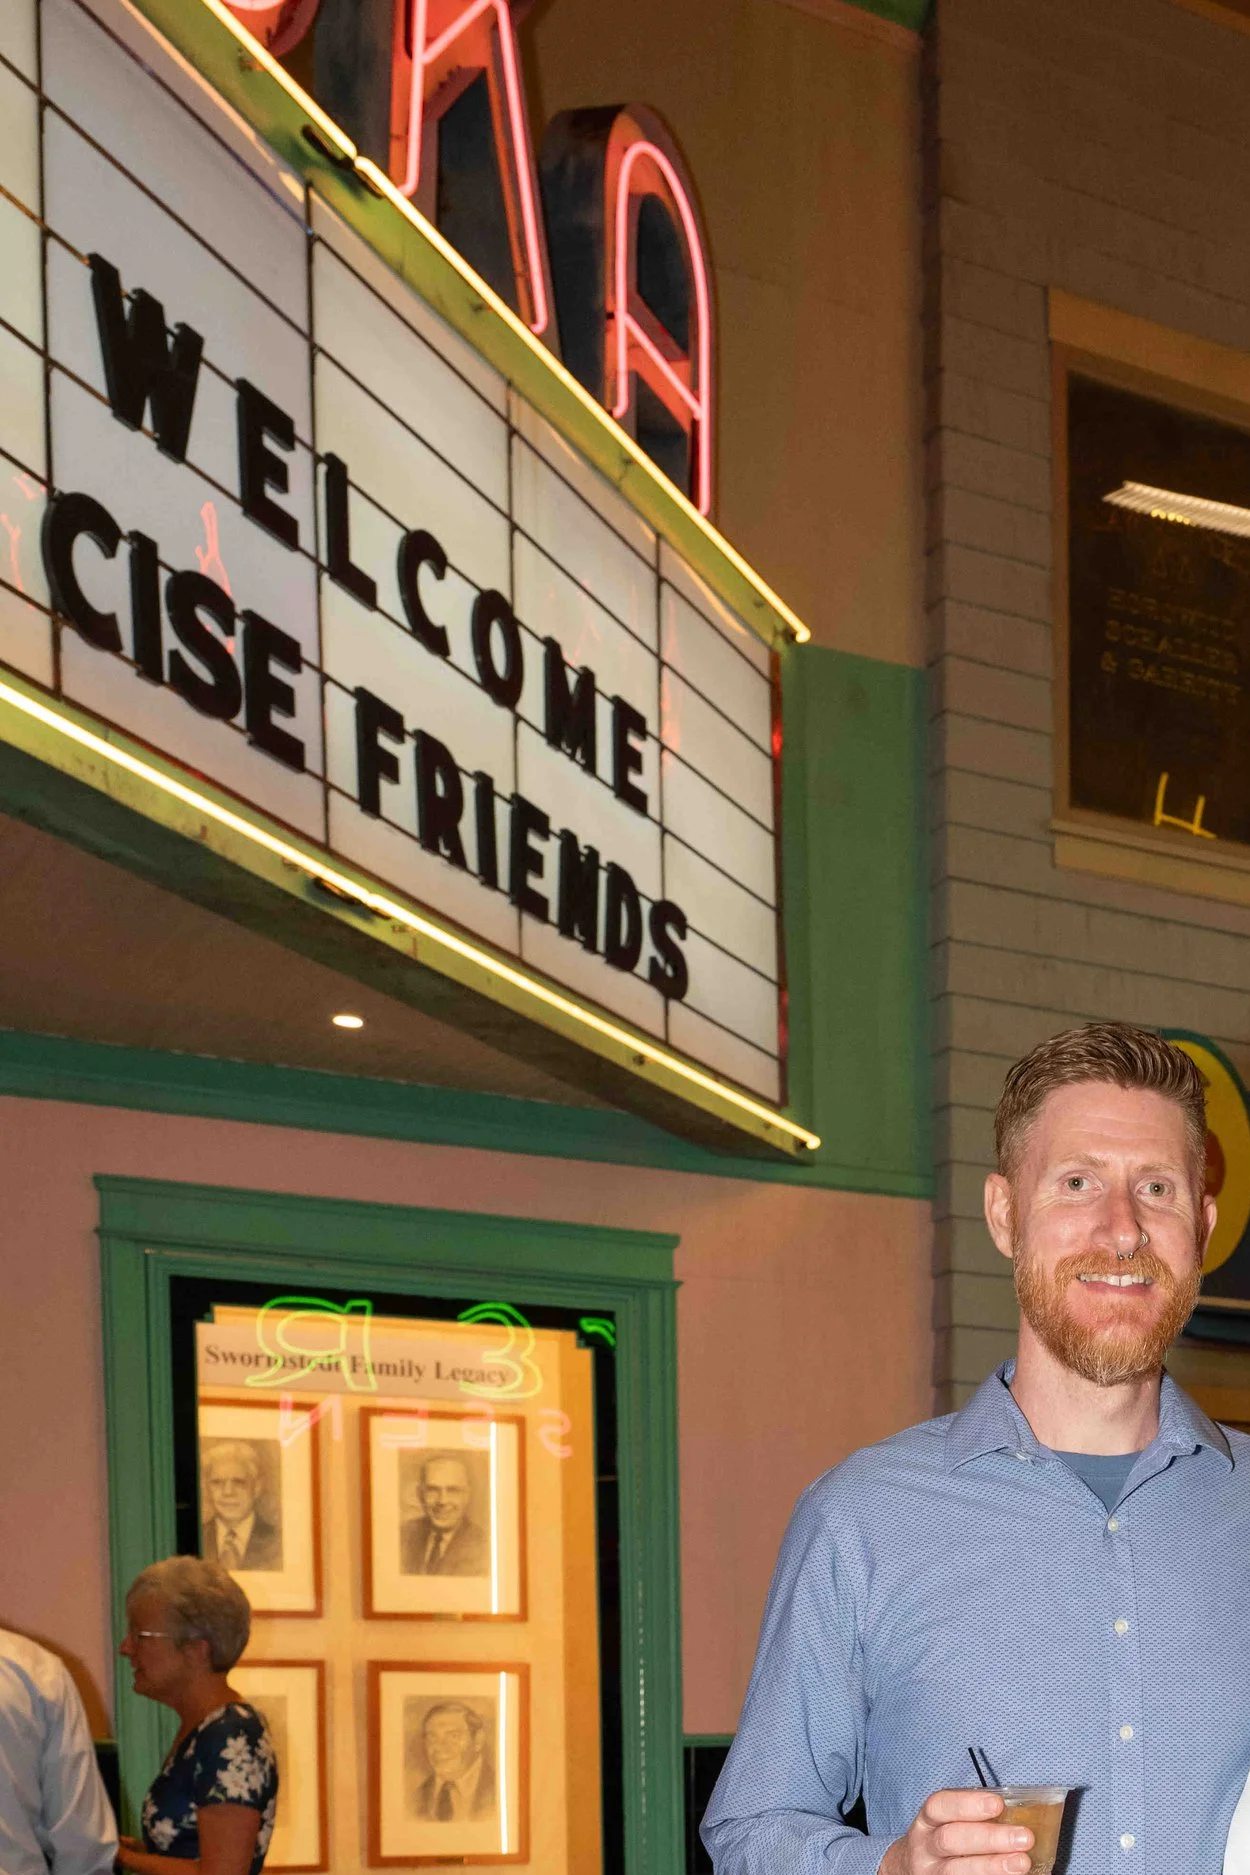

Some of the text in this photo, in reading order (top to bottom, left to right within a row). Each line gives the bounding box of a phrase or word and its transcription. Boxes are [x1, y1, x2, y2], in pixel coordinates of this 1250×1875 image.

[41, 492, 306, 774] CISE
[88, 253, 650, 818] WELCOME
[355, 686, 689, 1001] FRIENDS
[205, 1344, 509, 1389] Swormstedt Family Legacy
